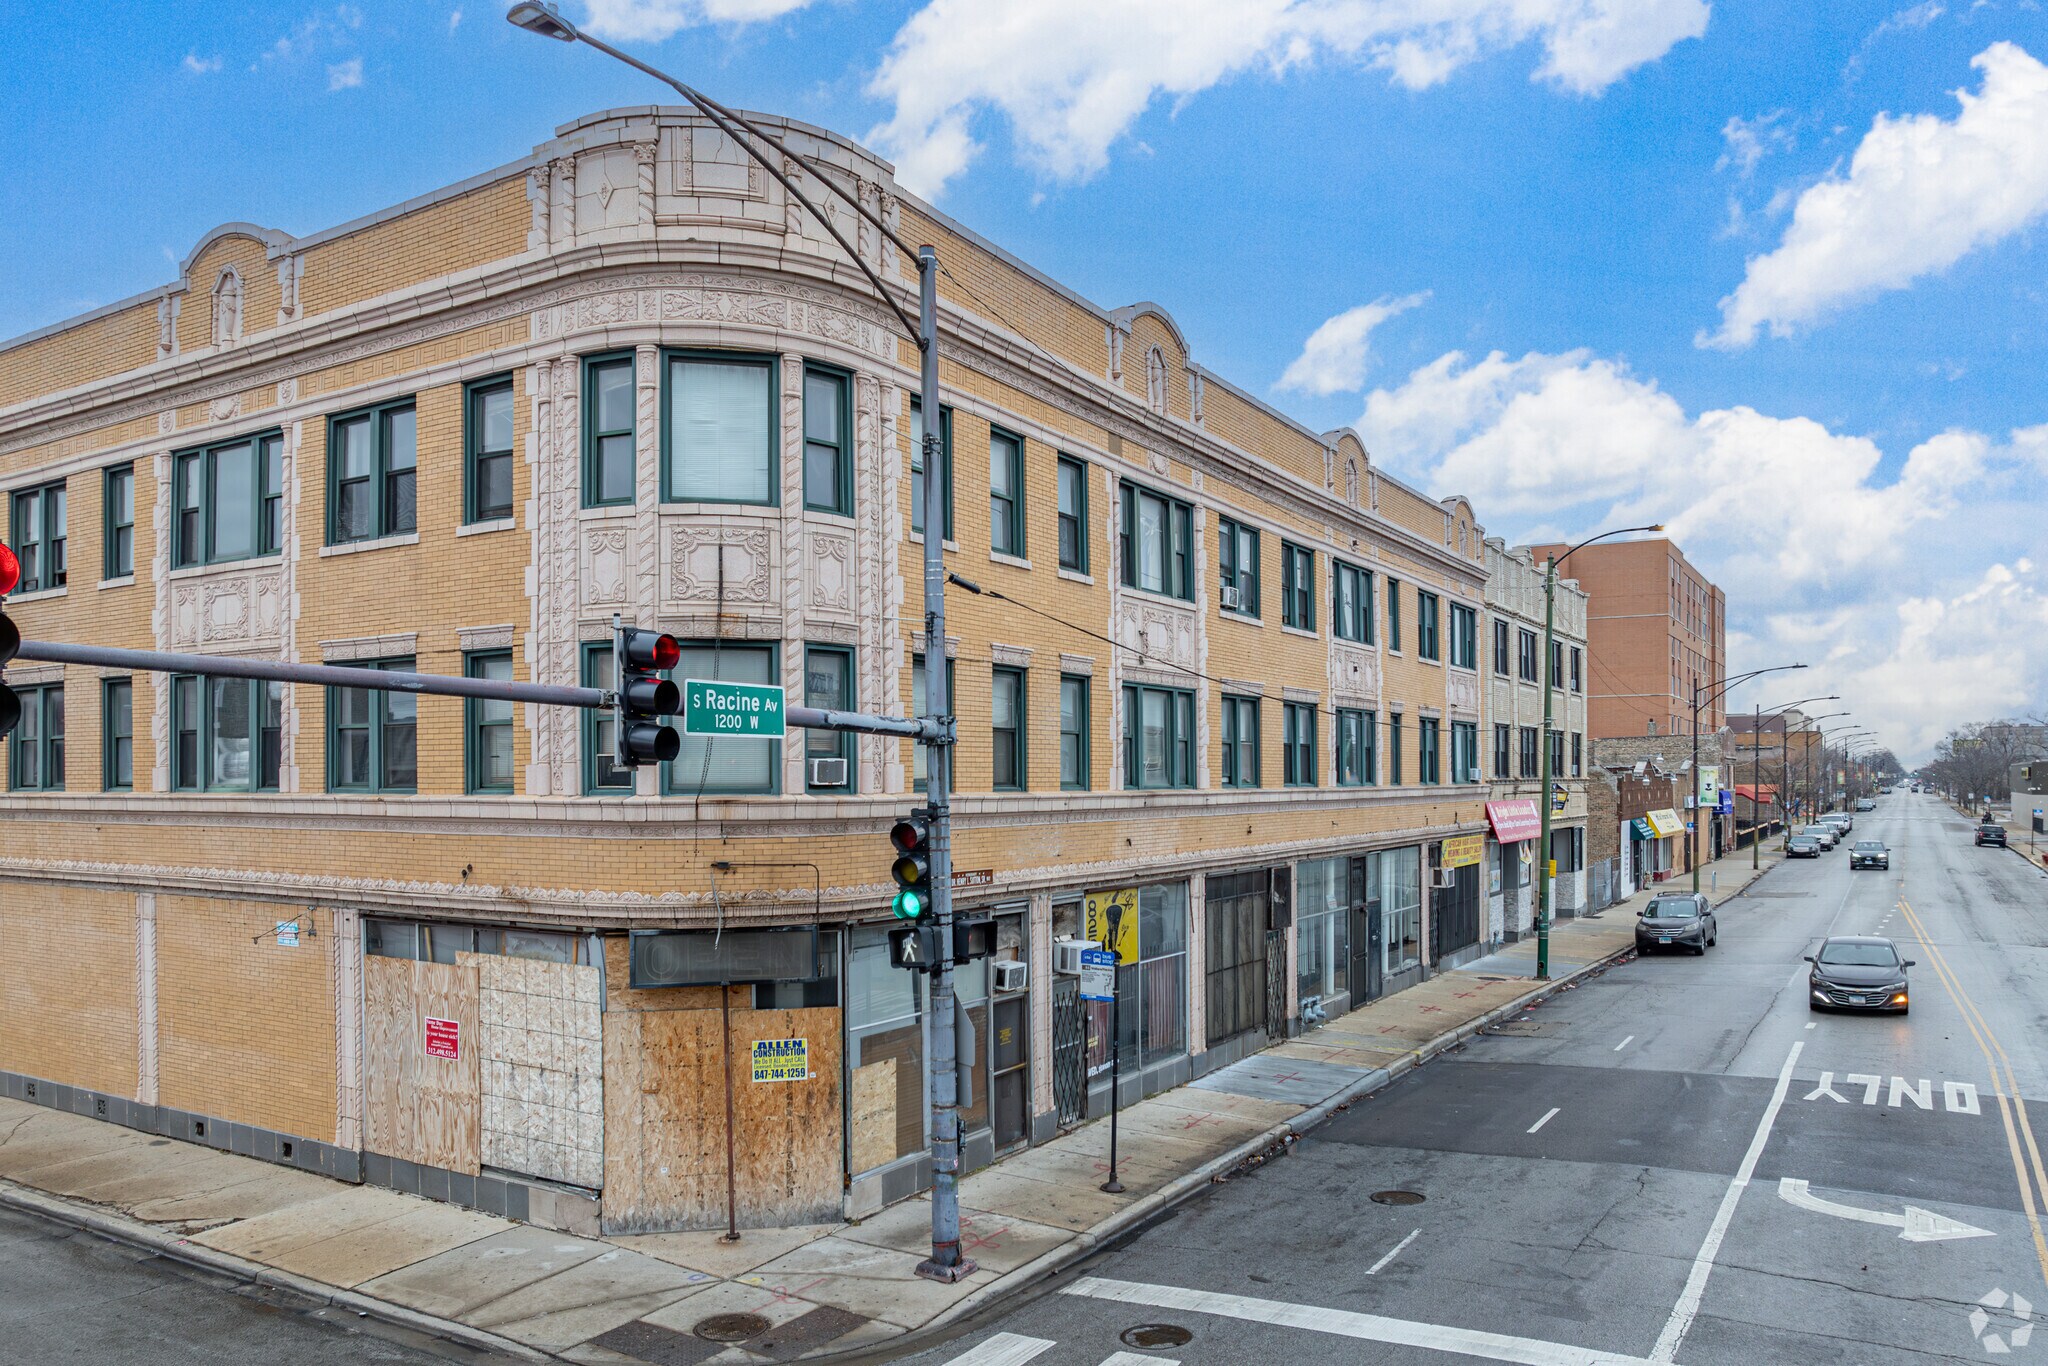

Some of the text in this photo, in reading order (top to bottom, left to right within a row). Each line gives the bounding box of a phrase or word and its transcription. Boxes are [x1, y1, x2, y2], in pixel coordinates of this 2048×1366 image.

[693, 689, 778, 713] S Racine Av
[714, 713, 759, 730] 1200 W
[643, 933, 805, 982] OPEN
[754, 1048, 806, 1058] CONSTRUCTION
[757, 1040, 802, 1049] ALLEN
[755, 1068, 805, 1080] 847-744-1259
[1803, 1077, 1981, 1115] ONLY
